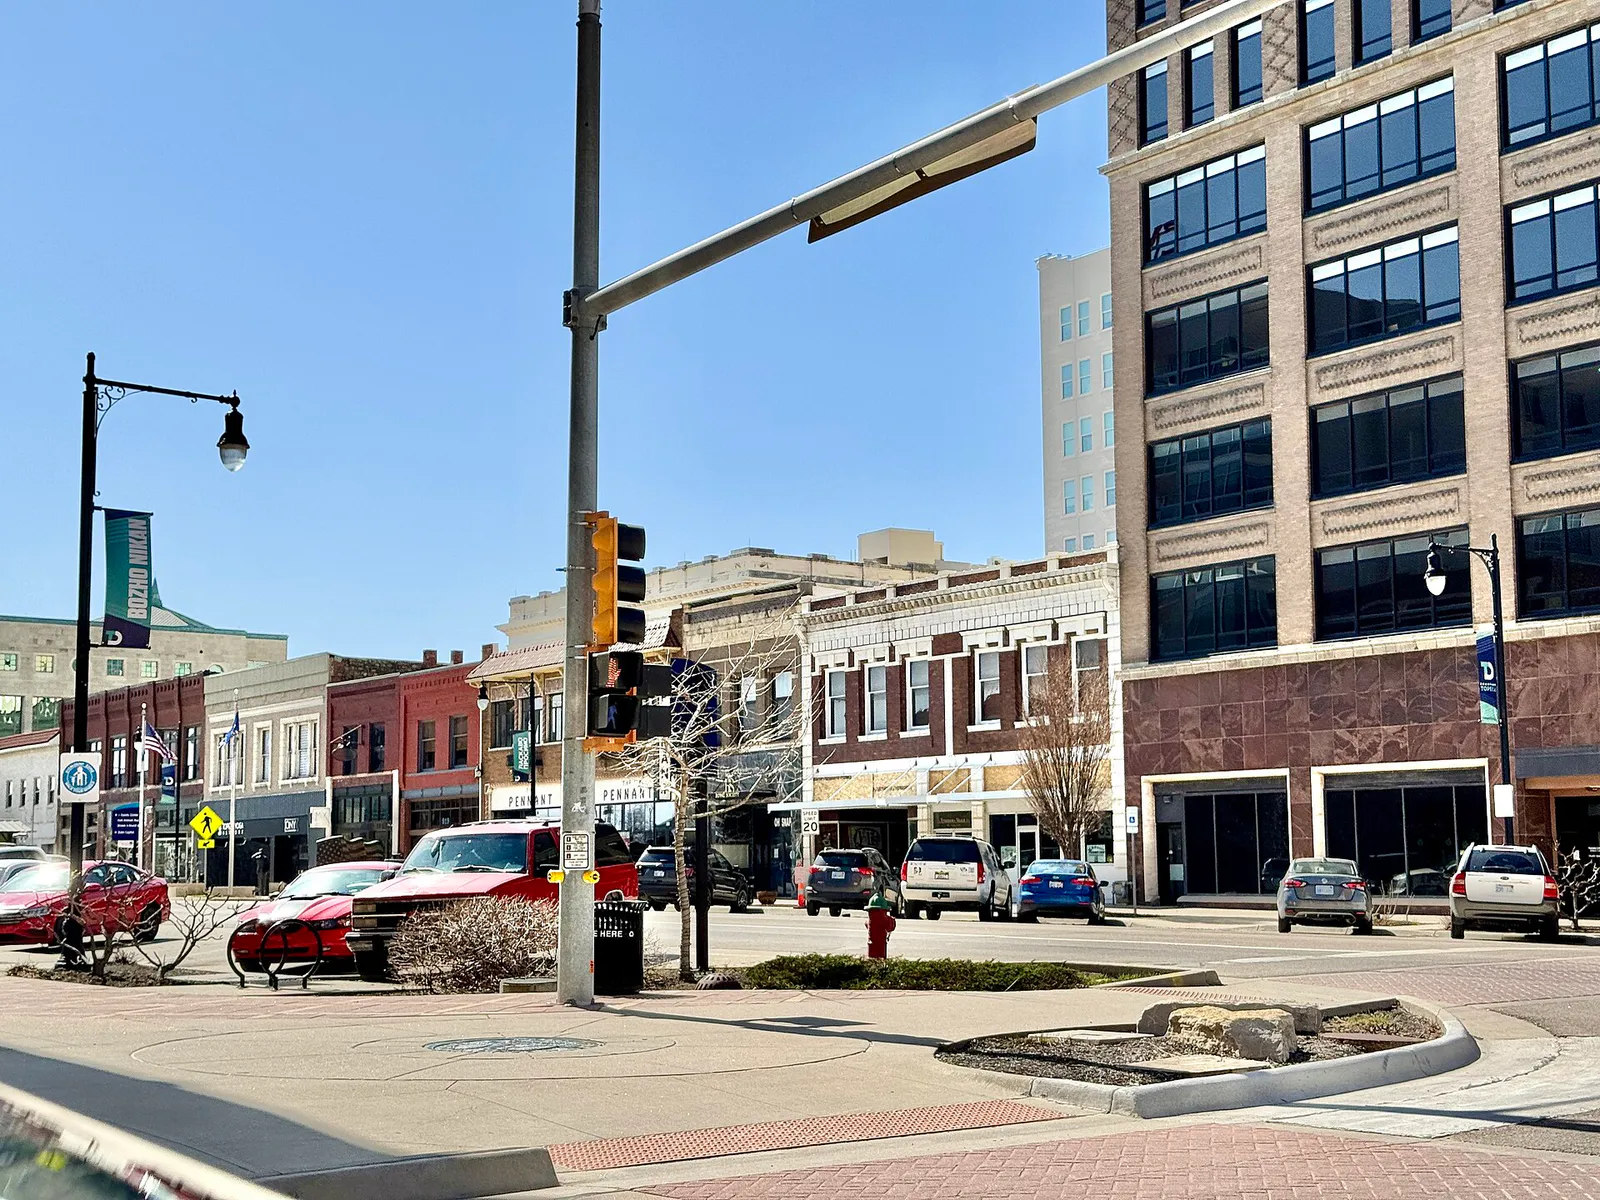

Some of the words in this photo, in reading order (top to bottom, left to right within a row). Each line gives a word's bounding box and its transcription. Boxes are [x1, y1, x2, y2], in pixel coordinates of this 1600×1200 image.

[128, 518, 148, 566] NIKAN
[127, 567, 149, 620] BOZHO
[602, 786, 653, 801] PENNANT
[508, 794, 553, 808] PENNANT
[803, 821, 818, 832] 20
[600, 930, 623, 938] HERE
